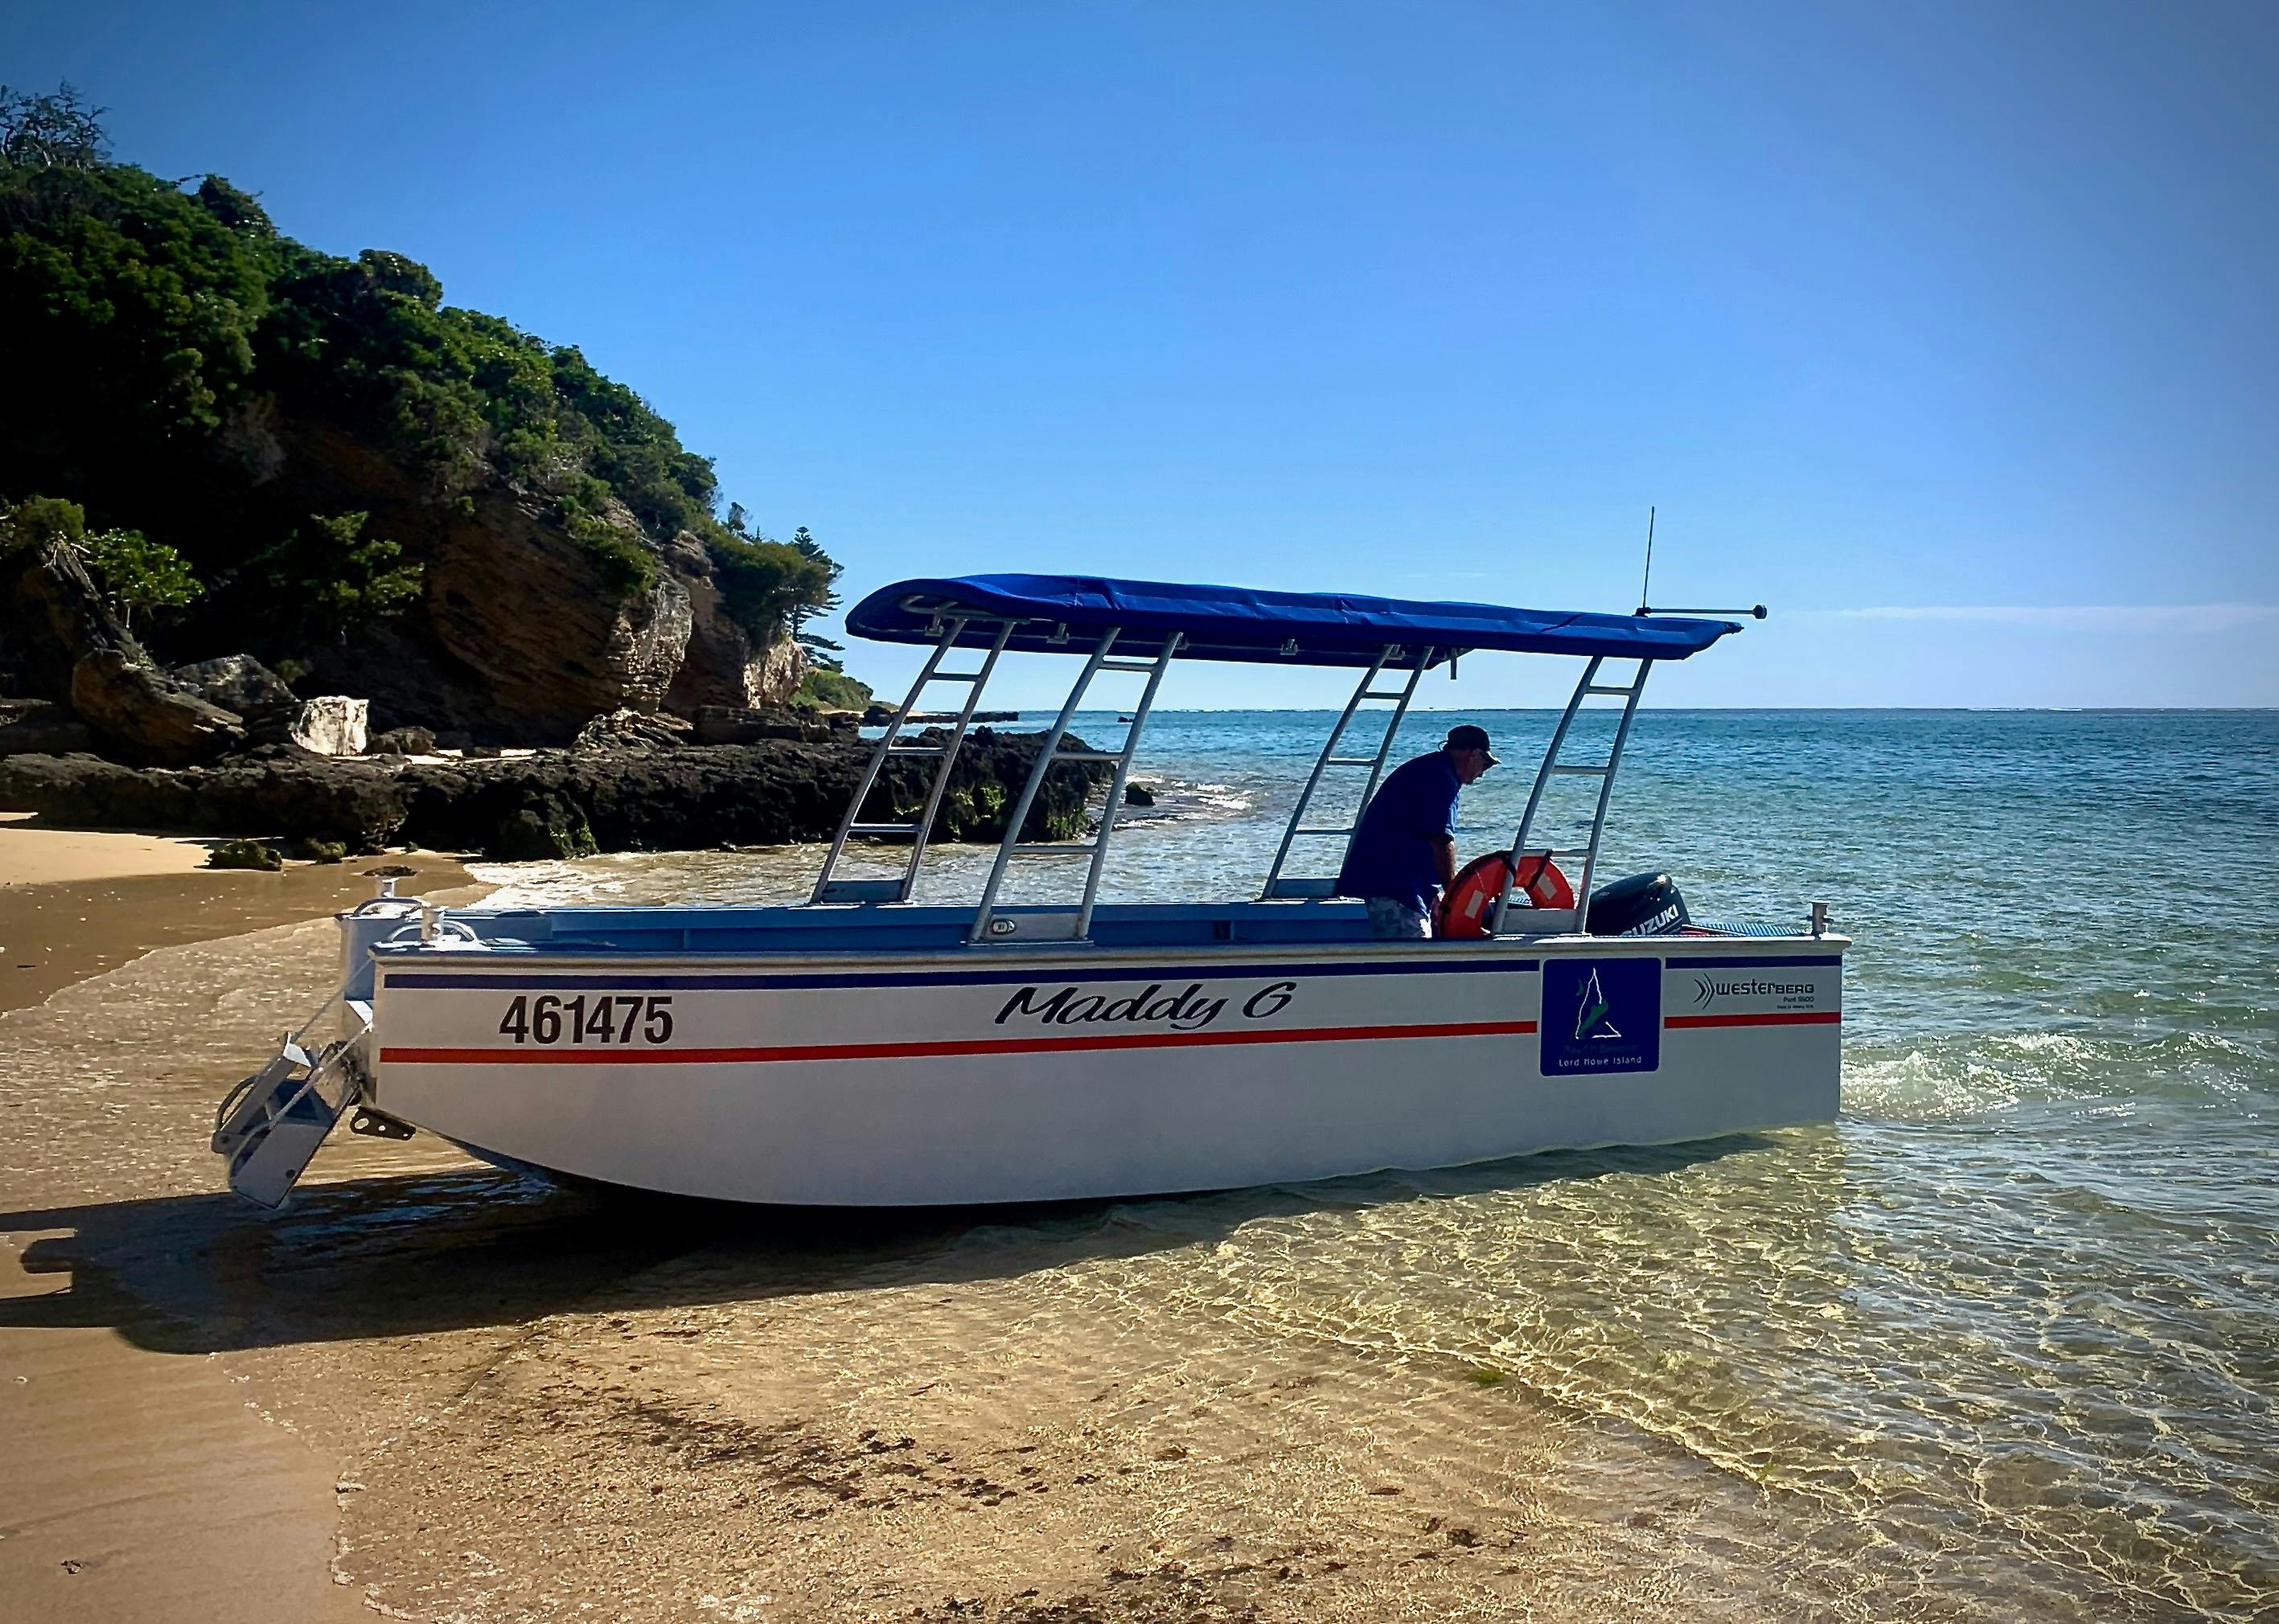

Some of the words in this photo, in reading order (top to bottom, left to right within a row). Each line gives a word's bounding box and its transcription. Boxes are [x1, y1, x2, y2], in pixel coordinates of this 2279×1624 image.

[499, 994, 673, 1044] 461475
[994, 983, 1230, 1031] Maddy
[1242, 981, 1298, 1019] G
[1558, 1059, 1579, 1067] Lord
[1613, 1056, 1642, 1064] Island
